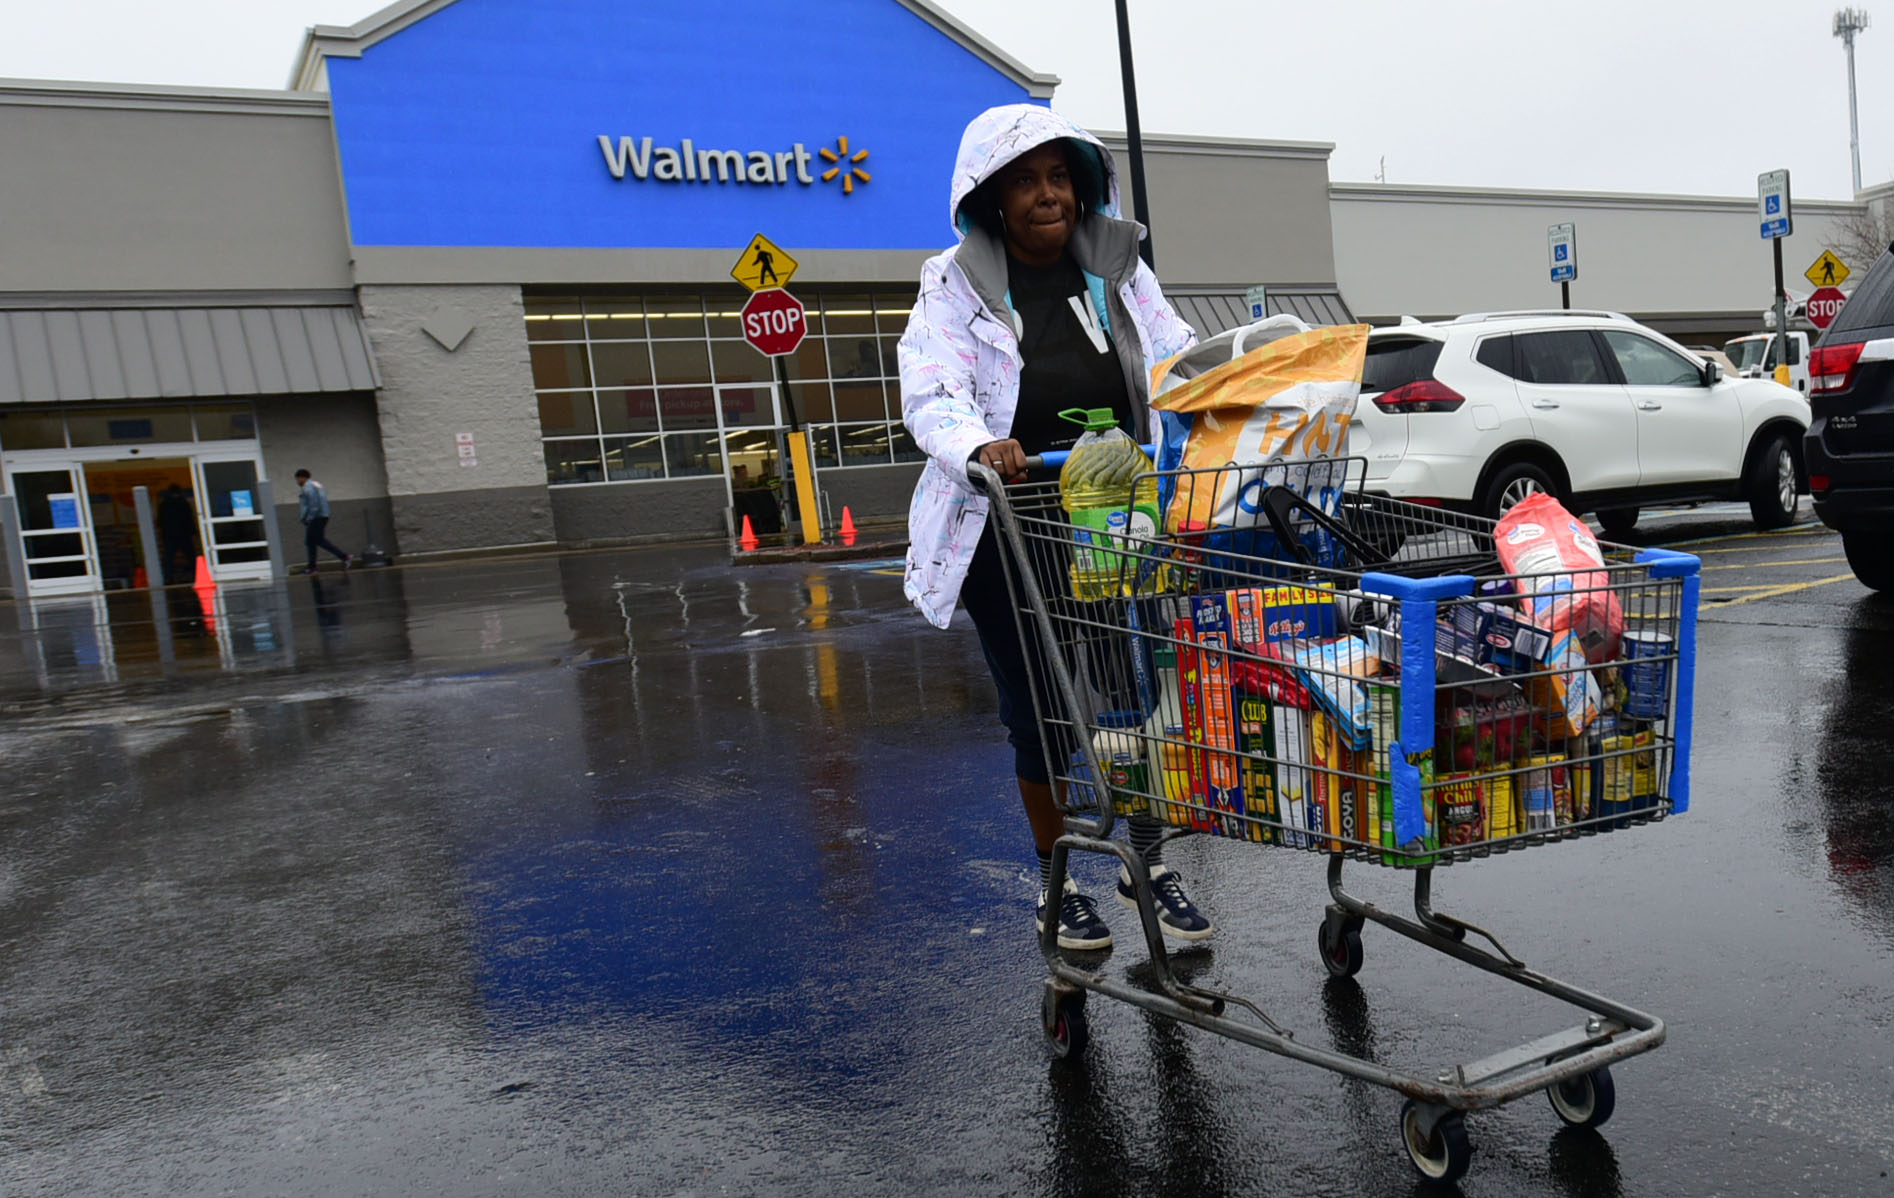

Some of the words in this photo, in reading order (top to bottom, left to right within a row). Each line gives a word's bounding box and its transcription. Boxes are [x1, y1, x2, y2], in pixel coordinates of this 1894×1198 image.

[597, 135, 815, 185] Walmart
[746, 307, 801, 338] STOP
[1808, 299, 1846, 317] STOP
[1342, 791, 1354, 840] GOYA
